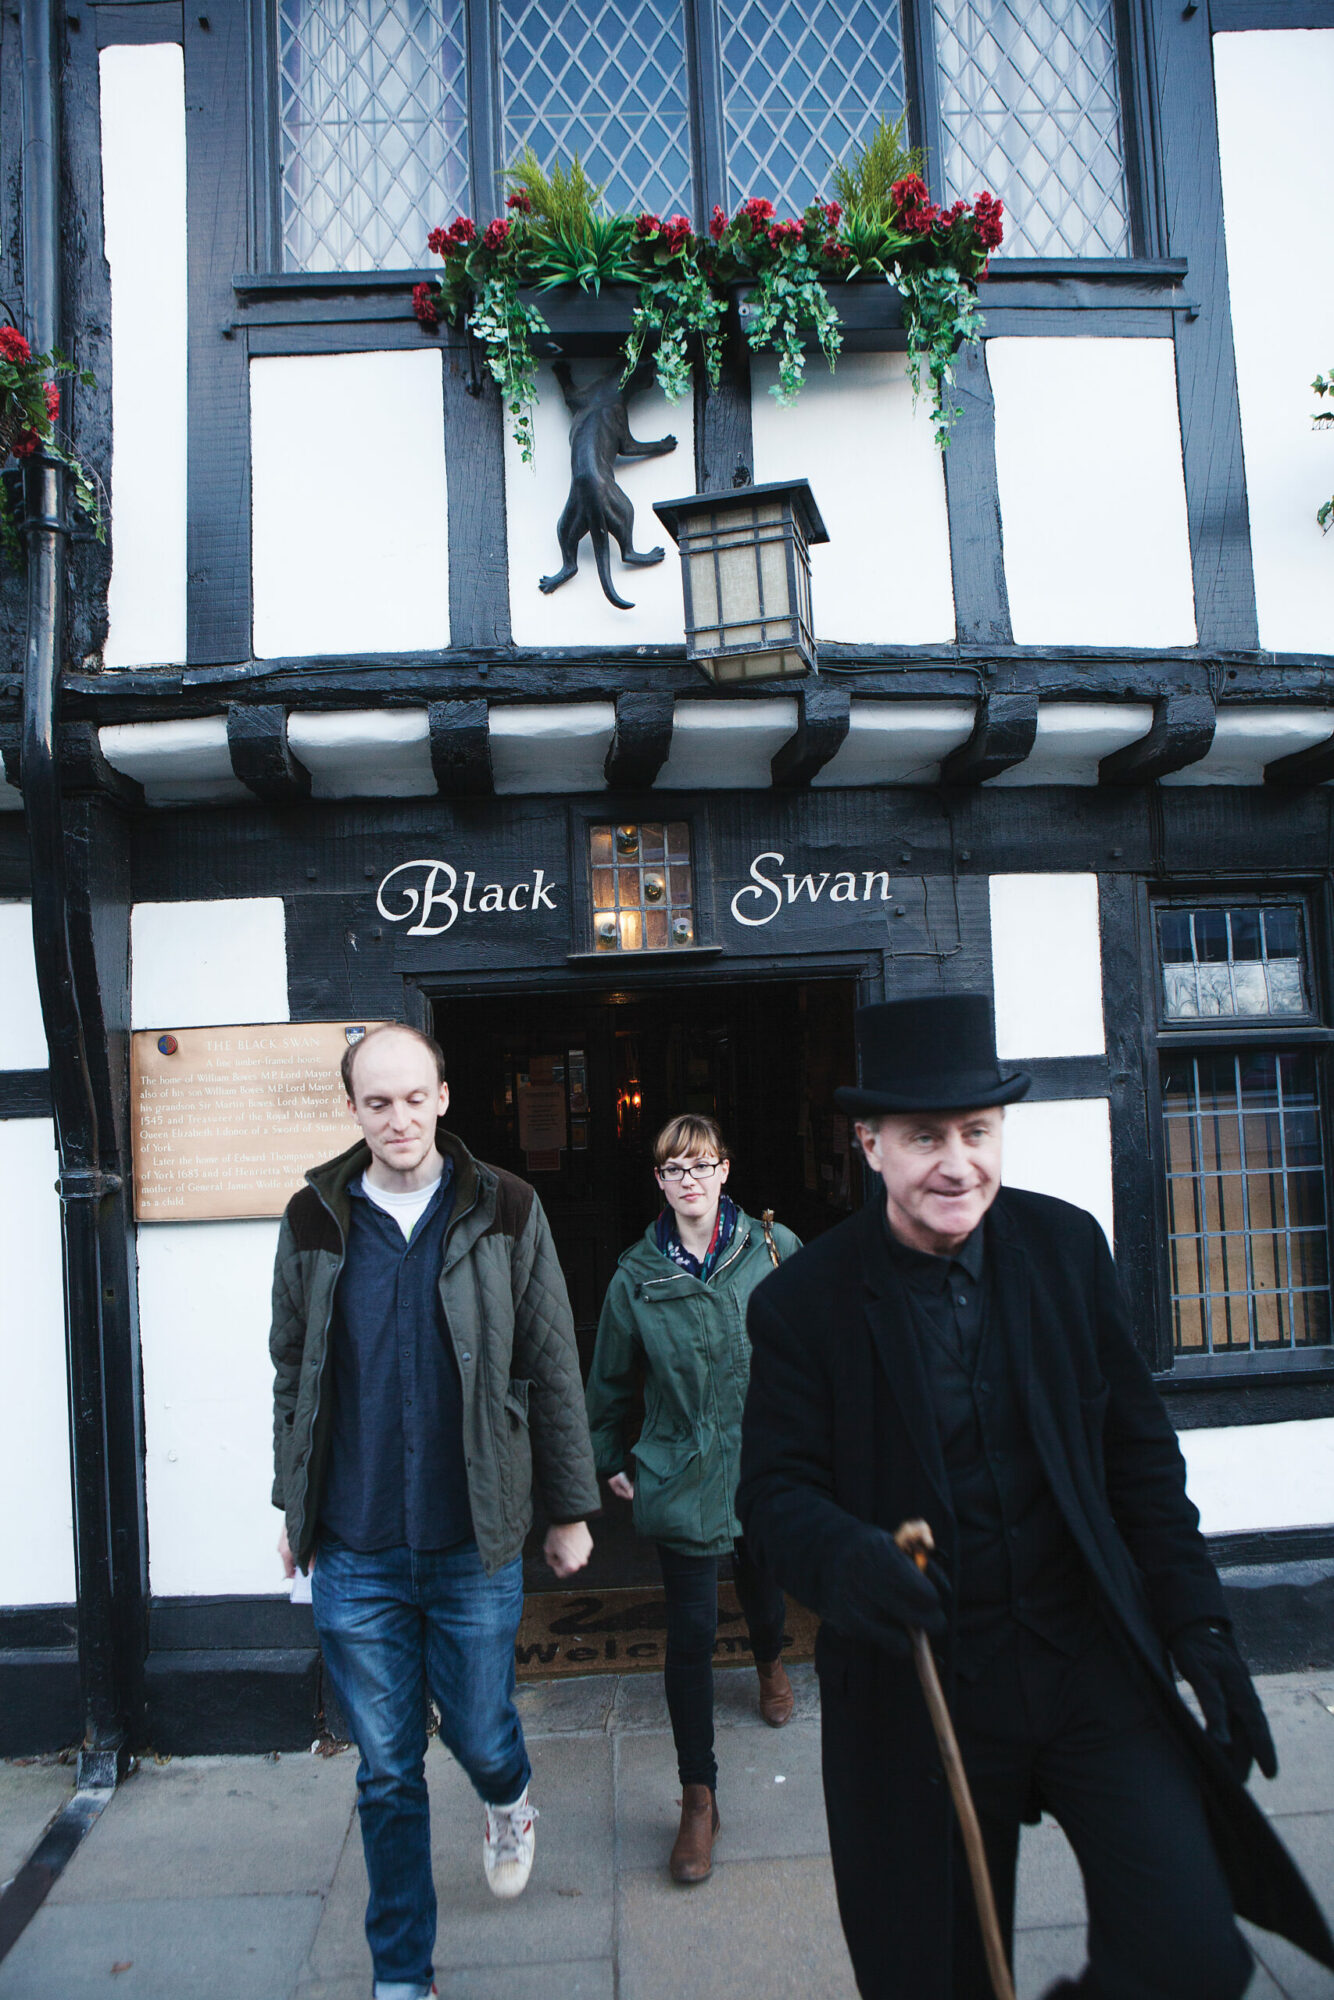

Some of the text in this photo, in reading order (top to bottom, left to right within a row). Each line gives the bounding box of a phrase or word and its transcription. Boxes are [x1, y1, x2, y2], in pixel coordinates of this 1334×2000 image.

[376, 852, 892, 936] Black Swan
[207, 1036, 321, 1051] THE BLACK SWAN
[206, 1060, 213, 1068] A
[141, 1075, 157, 1085] The
[159, 1075, 181, 1085] home
[184, 1074, 194, 1083] of
[197, 1072, 230, 1083] William
[232, 1071, 258, 1082] Bowes
[280, 1069, 300, 1079] Lord
[304, 1069, 332, 1081] Mayor
[140, 1088, 157, 1099] also
[160, 1088, 169, 1098] of
[172, 1087, 185, 1097] his
[204, 1086, 237, 1096] William
[240, 1084, 264, 1095] Bowes
[285, 1082, 306, 1093] Lord
[308, 1081, 334, 1093] Mayor
[140, 1102, 153, 1113] his
[155, 1102, 196, 1115] grandson
[199, 1100, 212, 1110] Sir
[215, 1099, 245, 1109] Martin
[277, 1096, 297, 1107] Lord
[301, 1095, 329, 1109] Mayor
[332, 1094, 341, 1104] of
[140, 1108, 346, 1126] 1545 and Treasurer of the Royal Mint in the
[139, 1129, 169, 1140] Queen
[171, 1127, 213, 1139] Elizabeth
[222, 1126, 249, 1137] donor
[251, 1126, 260, 1136] of
[271, 1123, 300, 1135] Sword
[302, 1123, 313, 1133] of
[315, 1122, 337, 1132] State
[140, 1143, 151, 1153] of
[152, 1155, 175, 1167] Later
[179, 1154, 193, 1165] the
[195, 1153, 218, 1164] home
[222, 1152, 231, 1163] of
[233, 1151, 266, 1163] Edward
[269, 1150, 314, 1163] Thompson
[141, 1170, 151, 1180] of
[152, 1169, 175, 1180] York
[202, 1167, 219, 1178] and
[222, 1166, 232, 1177] of
[235, 1166, 281, 1177] Henrietta
[141, 1183, 173, 1194] mother
[175, 1182, 185, 1193] of
[187, 1181, 223, 1193] General
[226, 1180, 254, 1191] James
[255, 1178, 281, 1190] Wolfe
[284, 1177, 294, 1188] of
